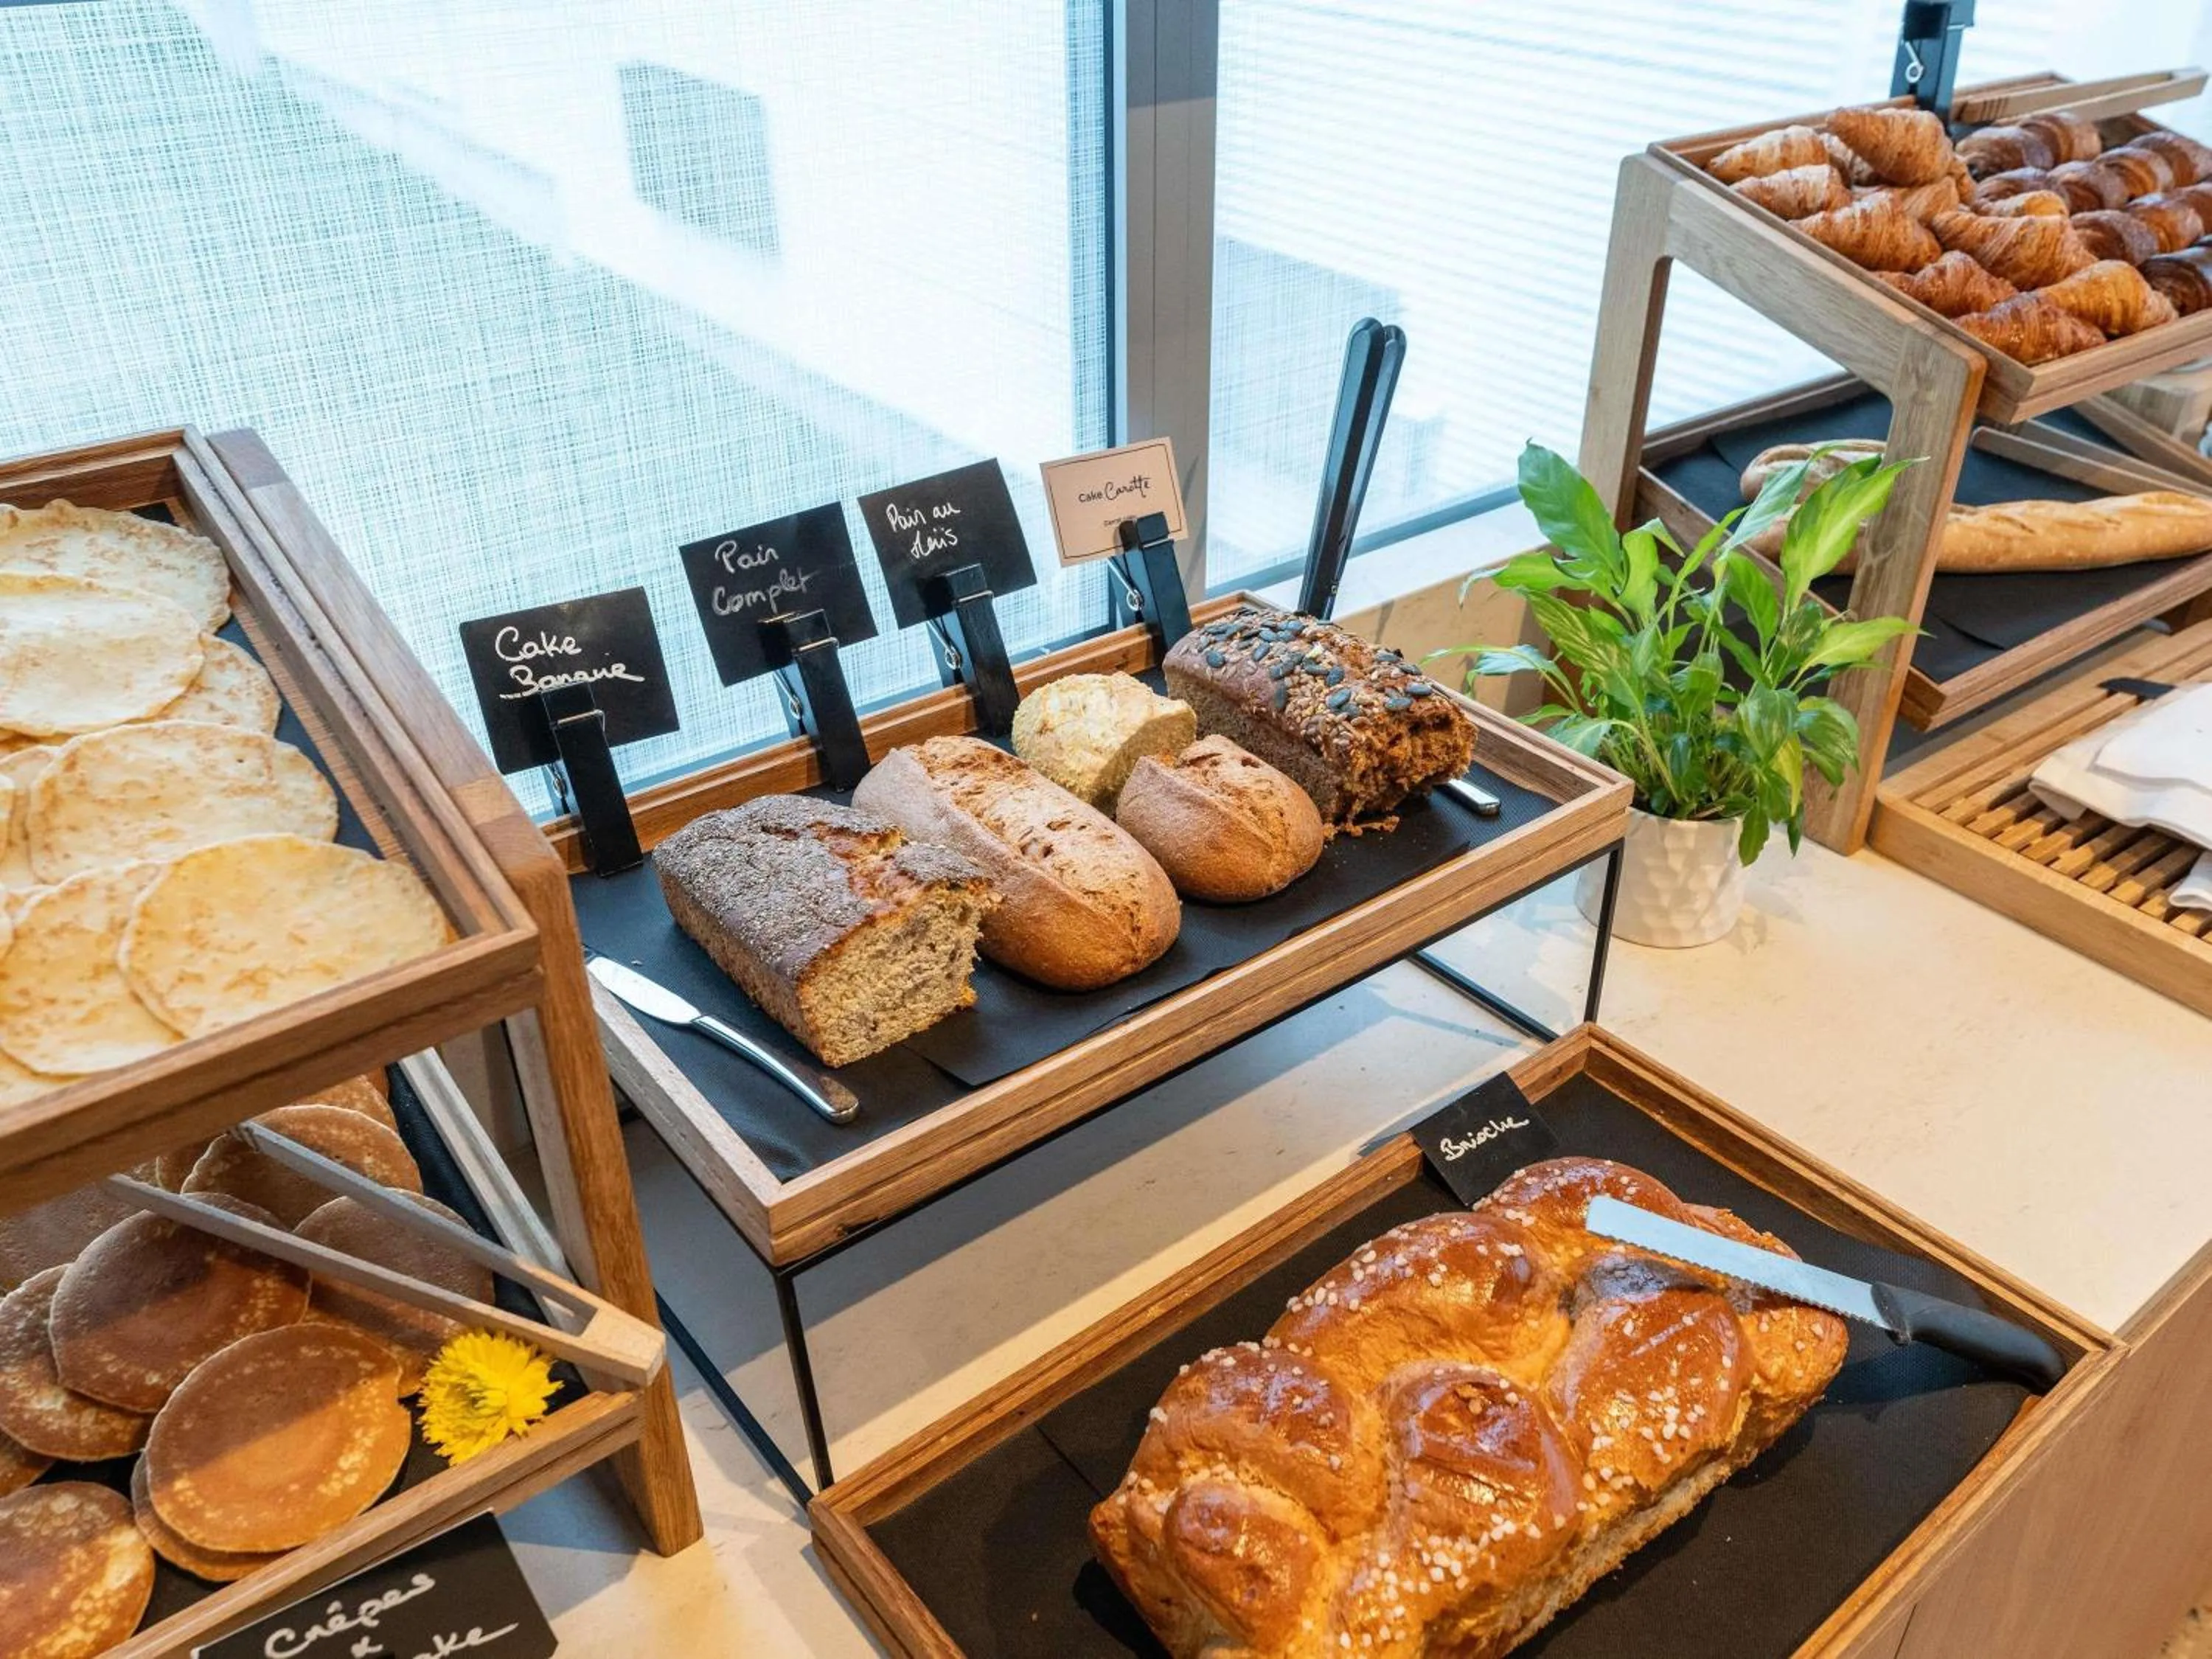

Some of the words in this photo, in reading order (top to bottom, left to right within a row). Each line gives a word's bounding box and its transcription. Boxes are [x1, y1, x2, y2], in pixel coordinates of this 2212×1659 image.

[886, 502, 927, 532] Pain
[932, 501, 961, 519] au
[714, 540, 779, 574] Pain
[495, 625, 582, 662] Cake
[1440, 1116, 1530, 1161] Brioche
[264, 1573, 437, 1659] Crêpes
